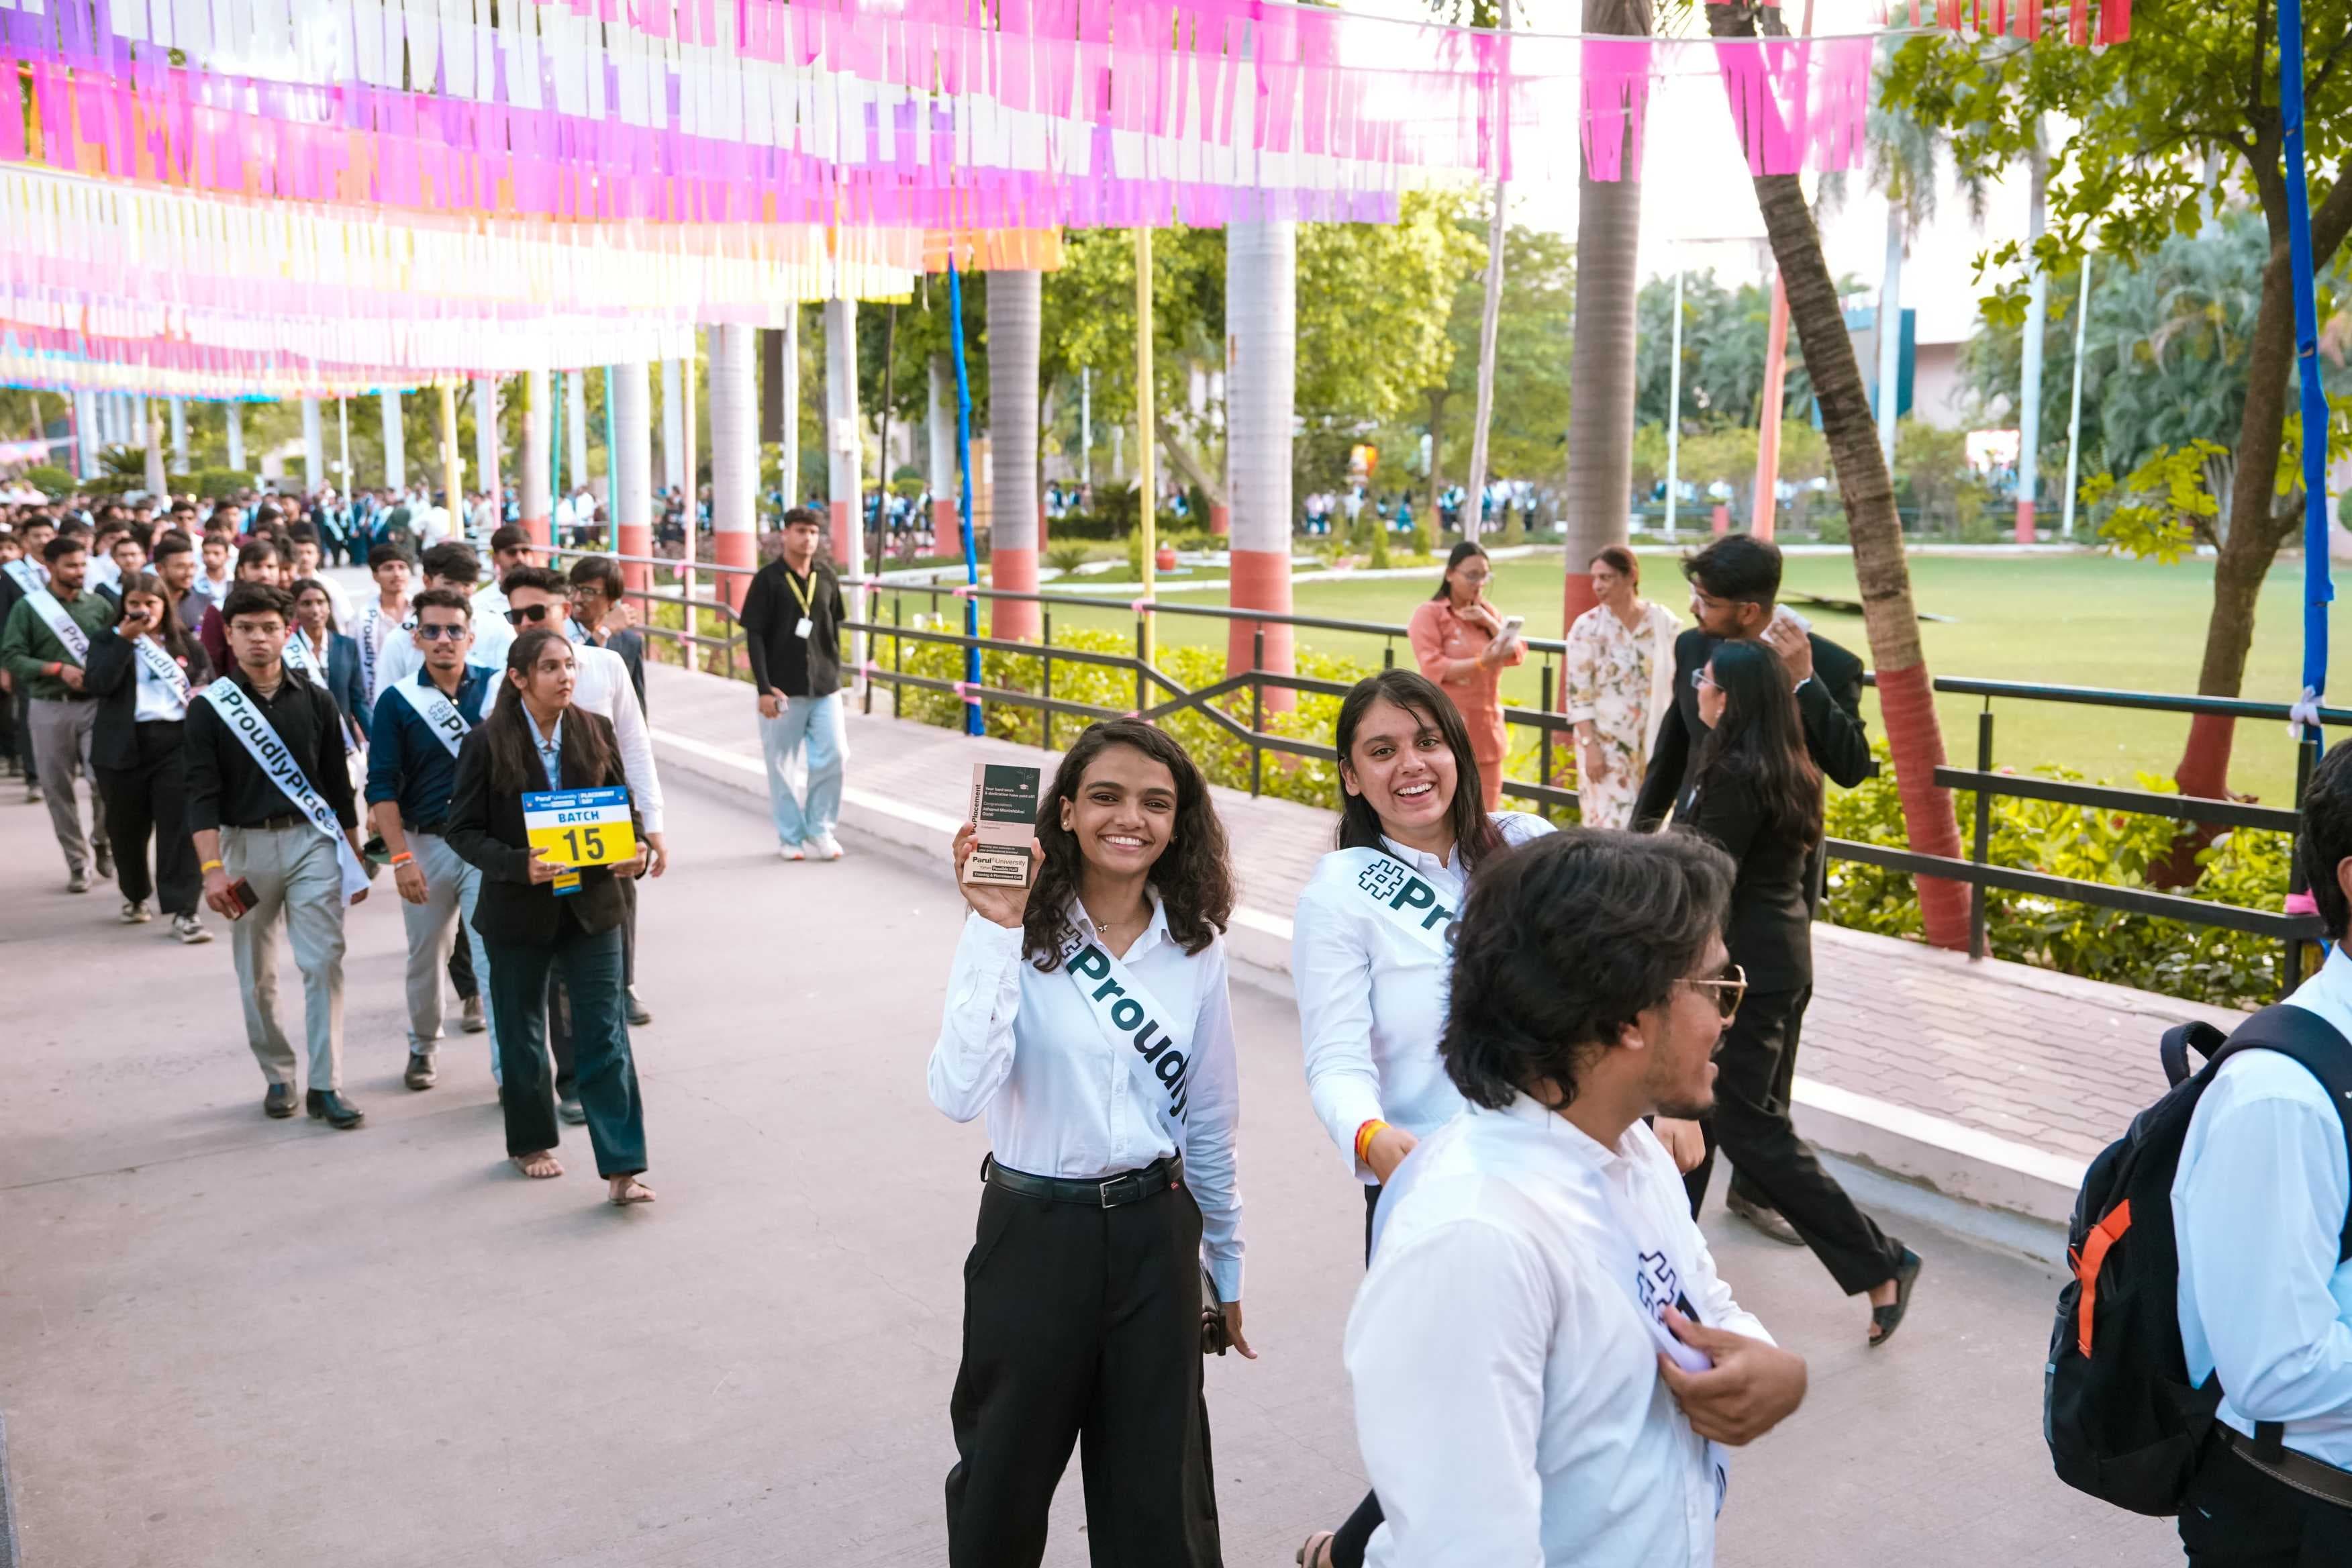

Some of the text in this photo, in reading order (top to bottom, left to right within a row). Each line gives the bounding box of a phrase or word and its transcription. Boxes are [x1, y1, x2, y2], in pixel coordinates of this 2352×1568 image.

[558, 810, 599, 823] BATCH
[562, 827, 604, 861] 15
[995, 859, 1026, 867] University
